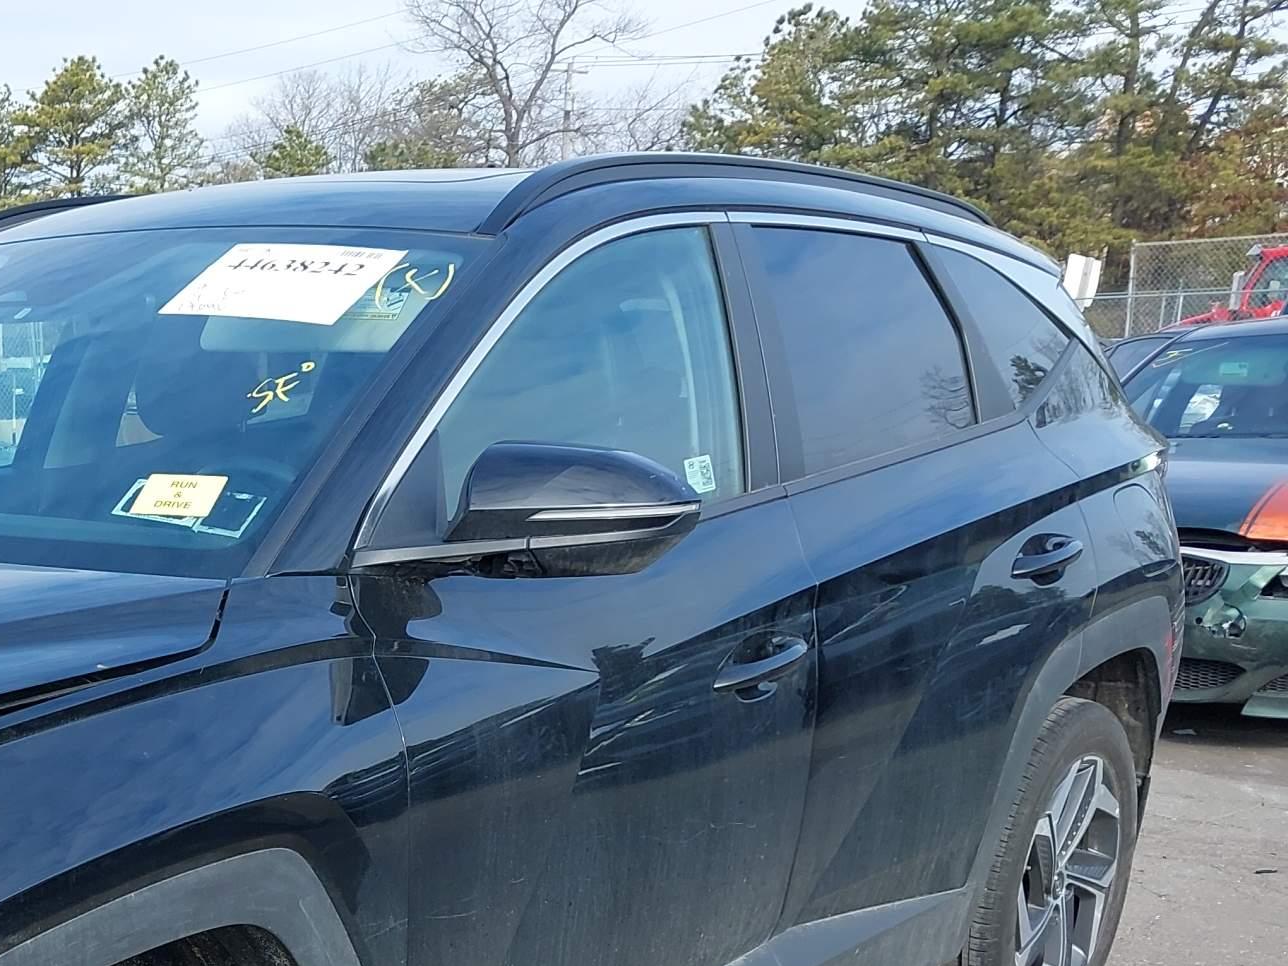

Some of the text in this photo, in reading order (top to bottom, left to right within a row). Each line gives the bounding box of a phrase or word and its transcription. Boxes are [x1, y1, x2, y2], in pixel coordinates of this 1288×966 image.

[227, 258, 365, 276] 44638242
[170, 480, 198, 489] RUN
[153, 500, 193, 509] DRIVE
